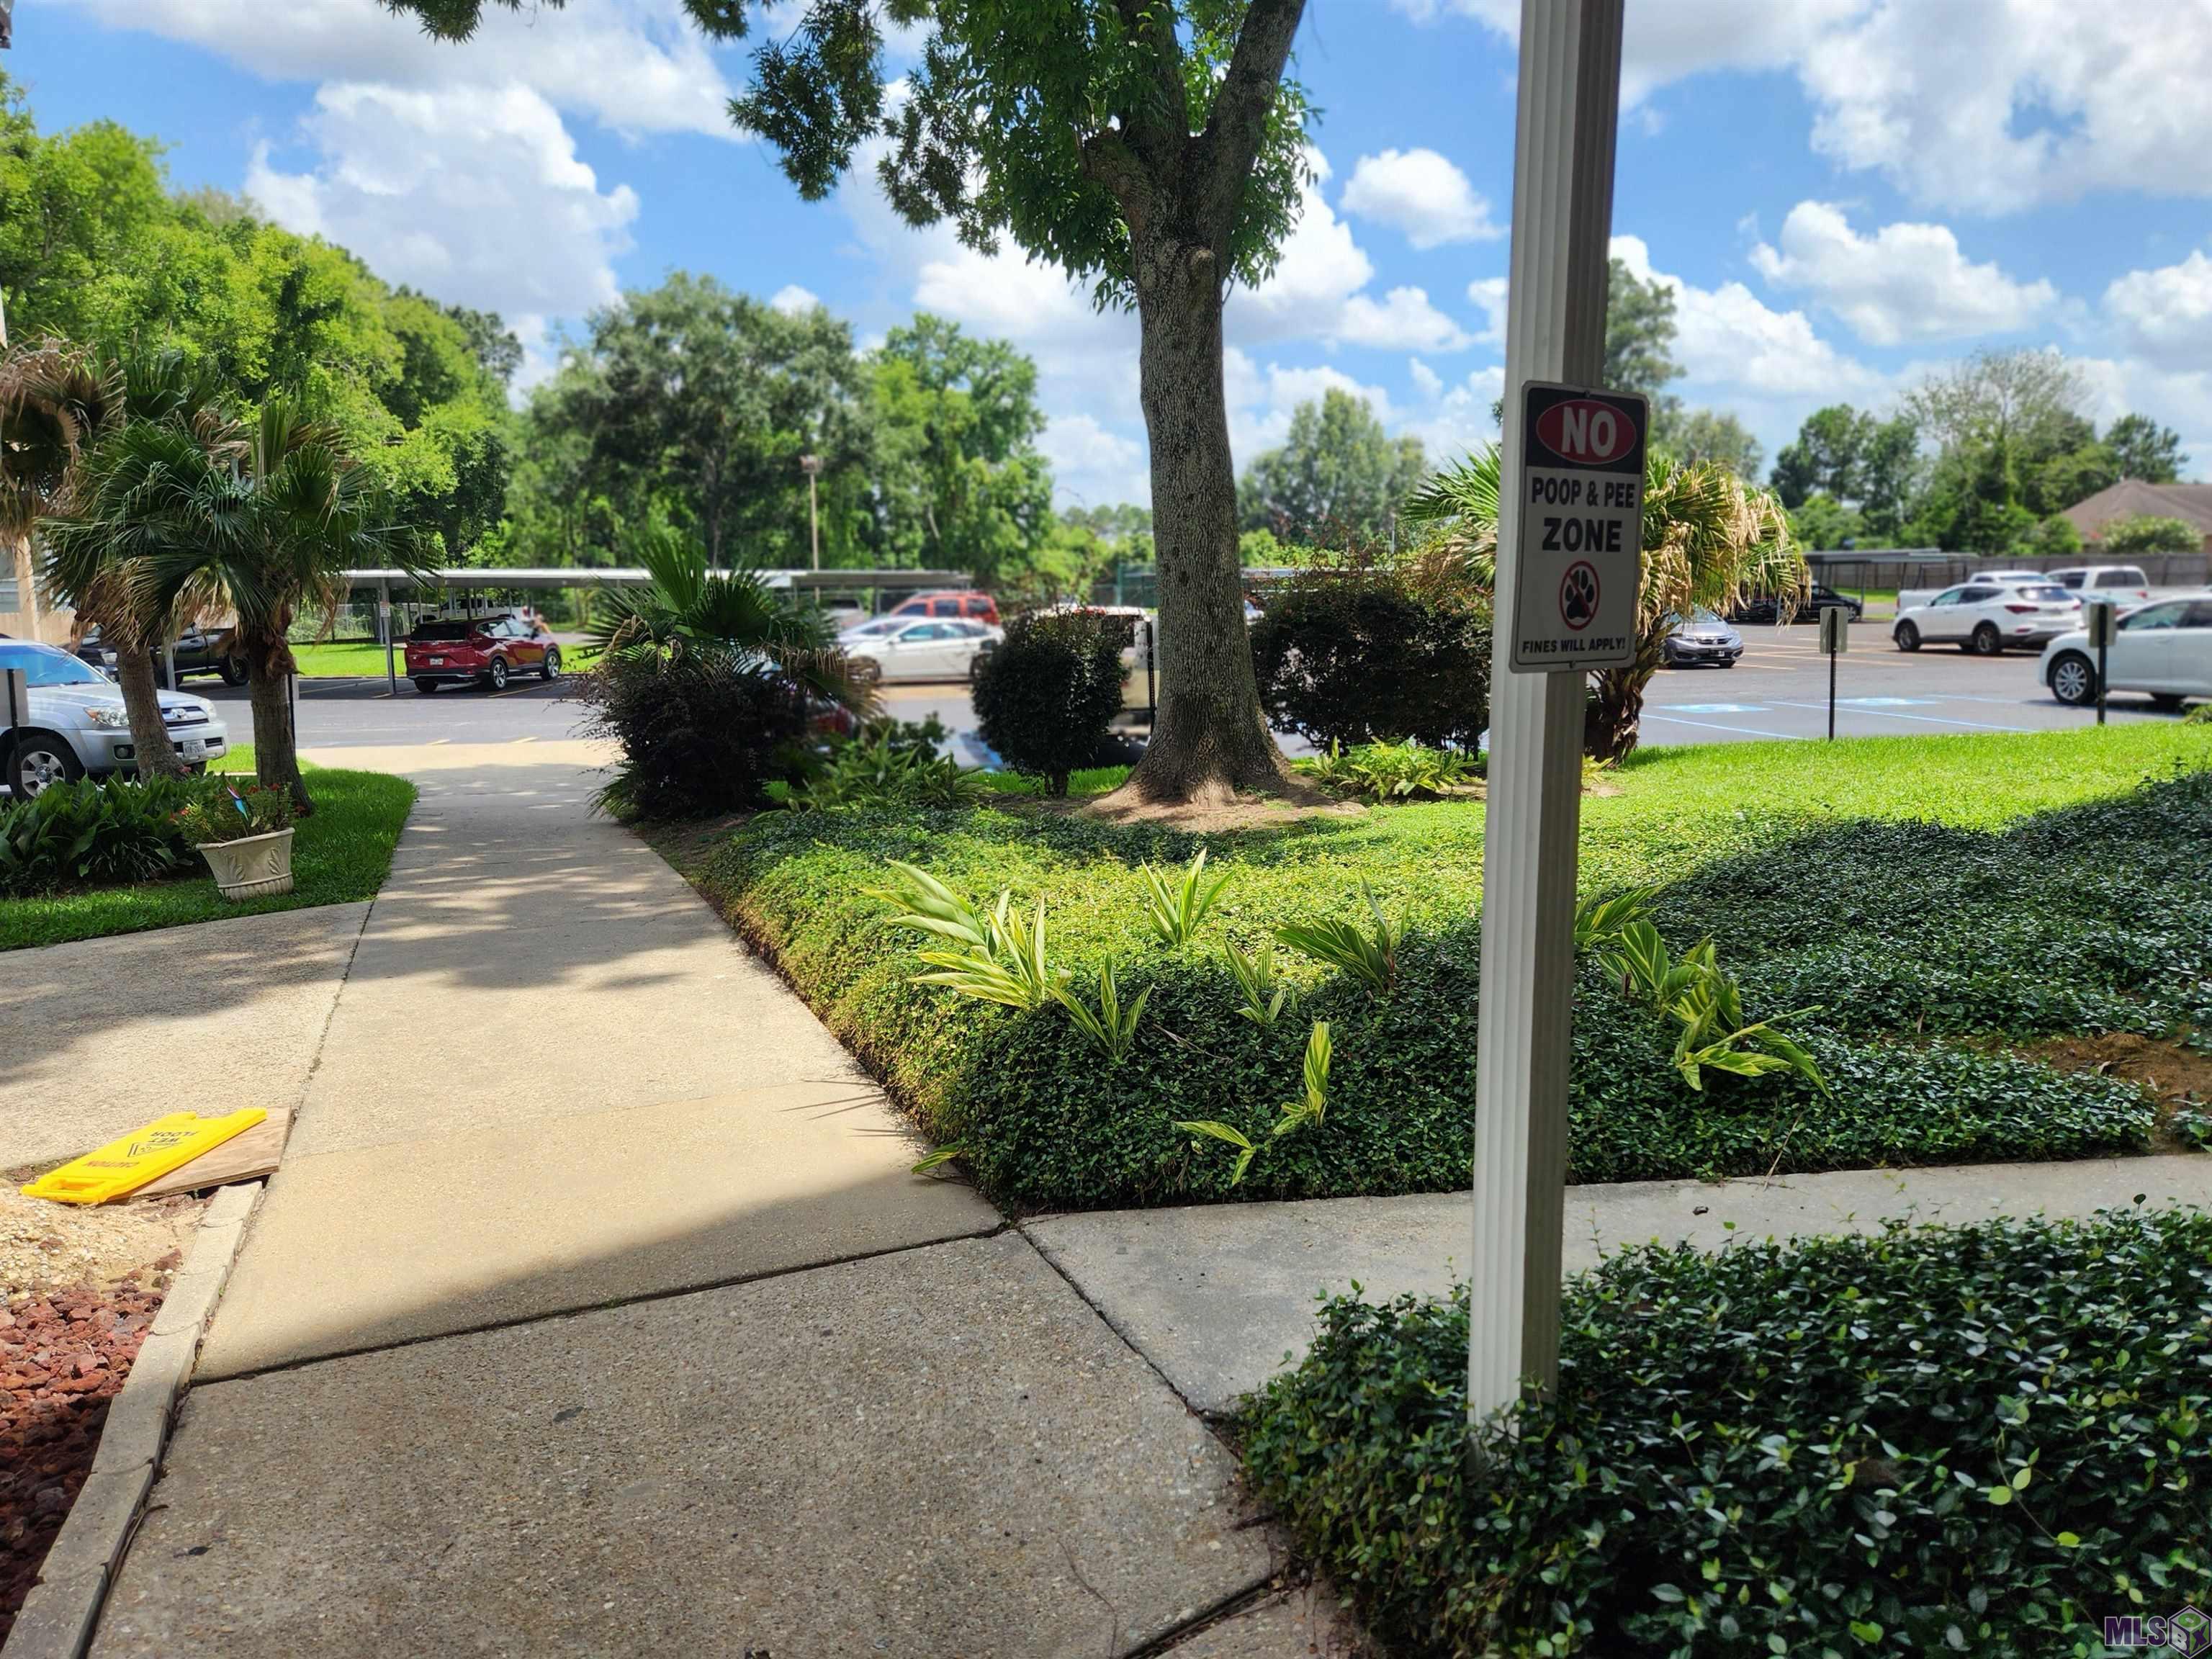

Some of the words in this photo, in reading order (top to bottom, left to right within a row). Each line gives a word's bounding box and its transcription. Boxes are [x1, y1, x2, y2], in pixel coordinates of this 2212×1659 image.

[1561, 406, 1617, 457] NO
[1532, 477, 1581, 505] POOP
[1586, 480, 1599, 507] &
[1604, 482, 1635, 508] PEE
[1542, 517, 1622, 552] ZONE
[1522, 639, 1557, 653] FINES
[1561, 639, 1585, 652] WILL
[1588, 637, 1626, 651] APPLY!
